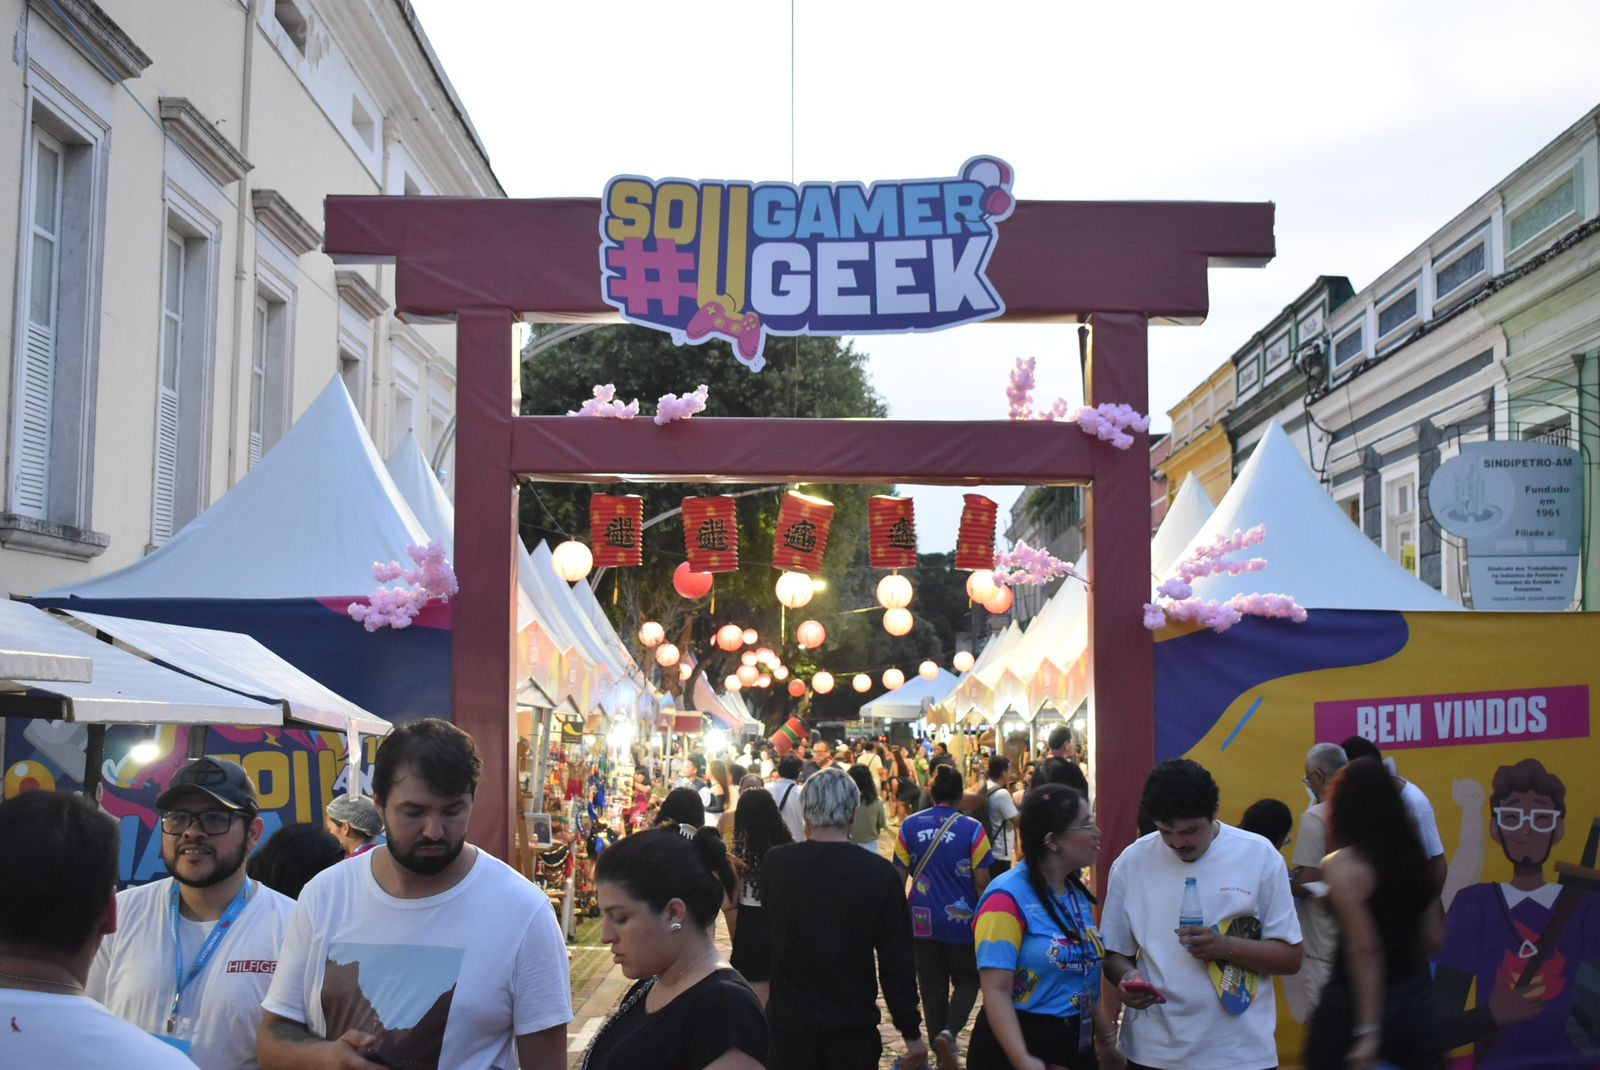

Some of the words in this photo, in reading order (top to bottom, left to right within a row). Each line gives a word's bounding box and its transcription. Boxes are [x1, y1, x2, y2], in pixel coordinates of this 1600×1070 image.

[753, 180, 986, 239] GAMER
[750, 236, 996, 316] GEEK
[1483, 458, 1573, 468] SINDIPETRO-AM
[1525, 485, 1570, 494] Fundado
[1536, 509, 1560, 517] 1961
[1515, 529, 1545, 537] Filiado
[1356, 703, 1422, 744] BEM
[1433, 695, 1548, 740] VINDOS
[227, 961, 278, 973] HILFIGE
